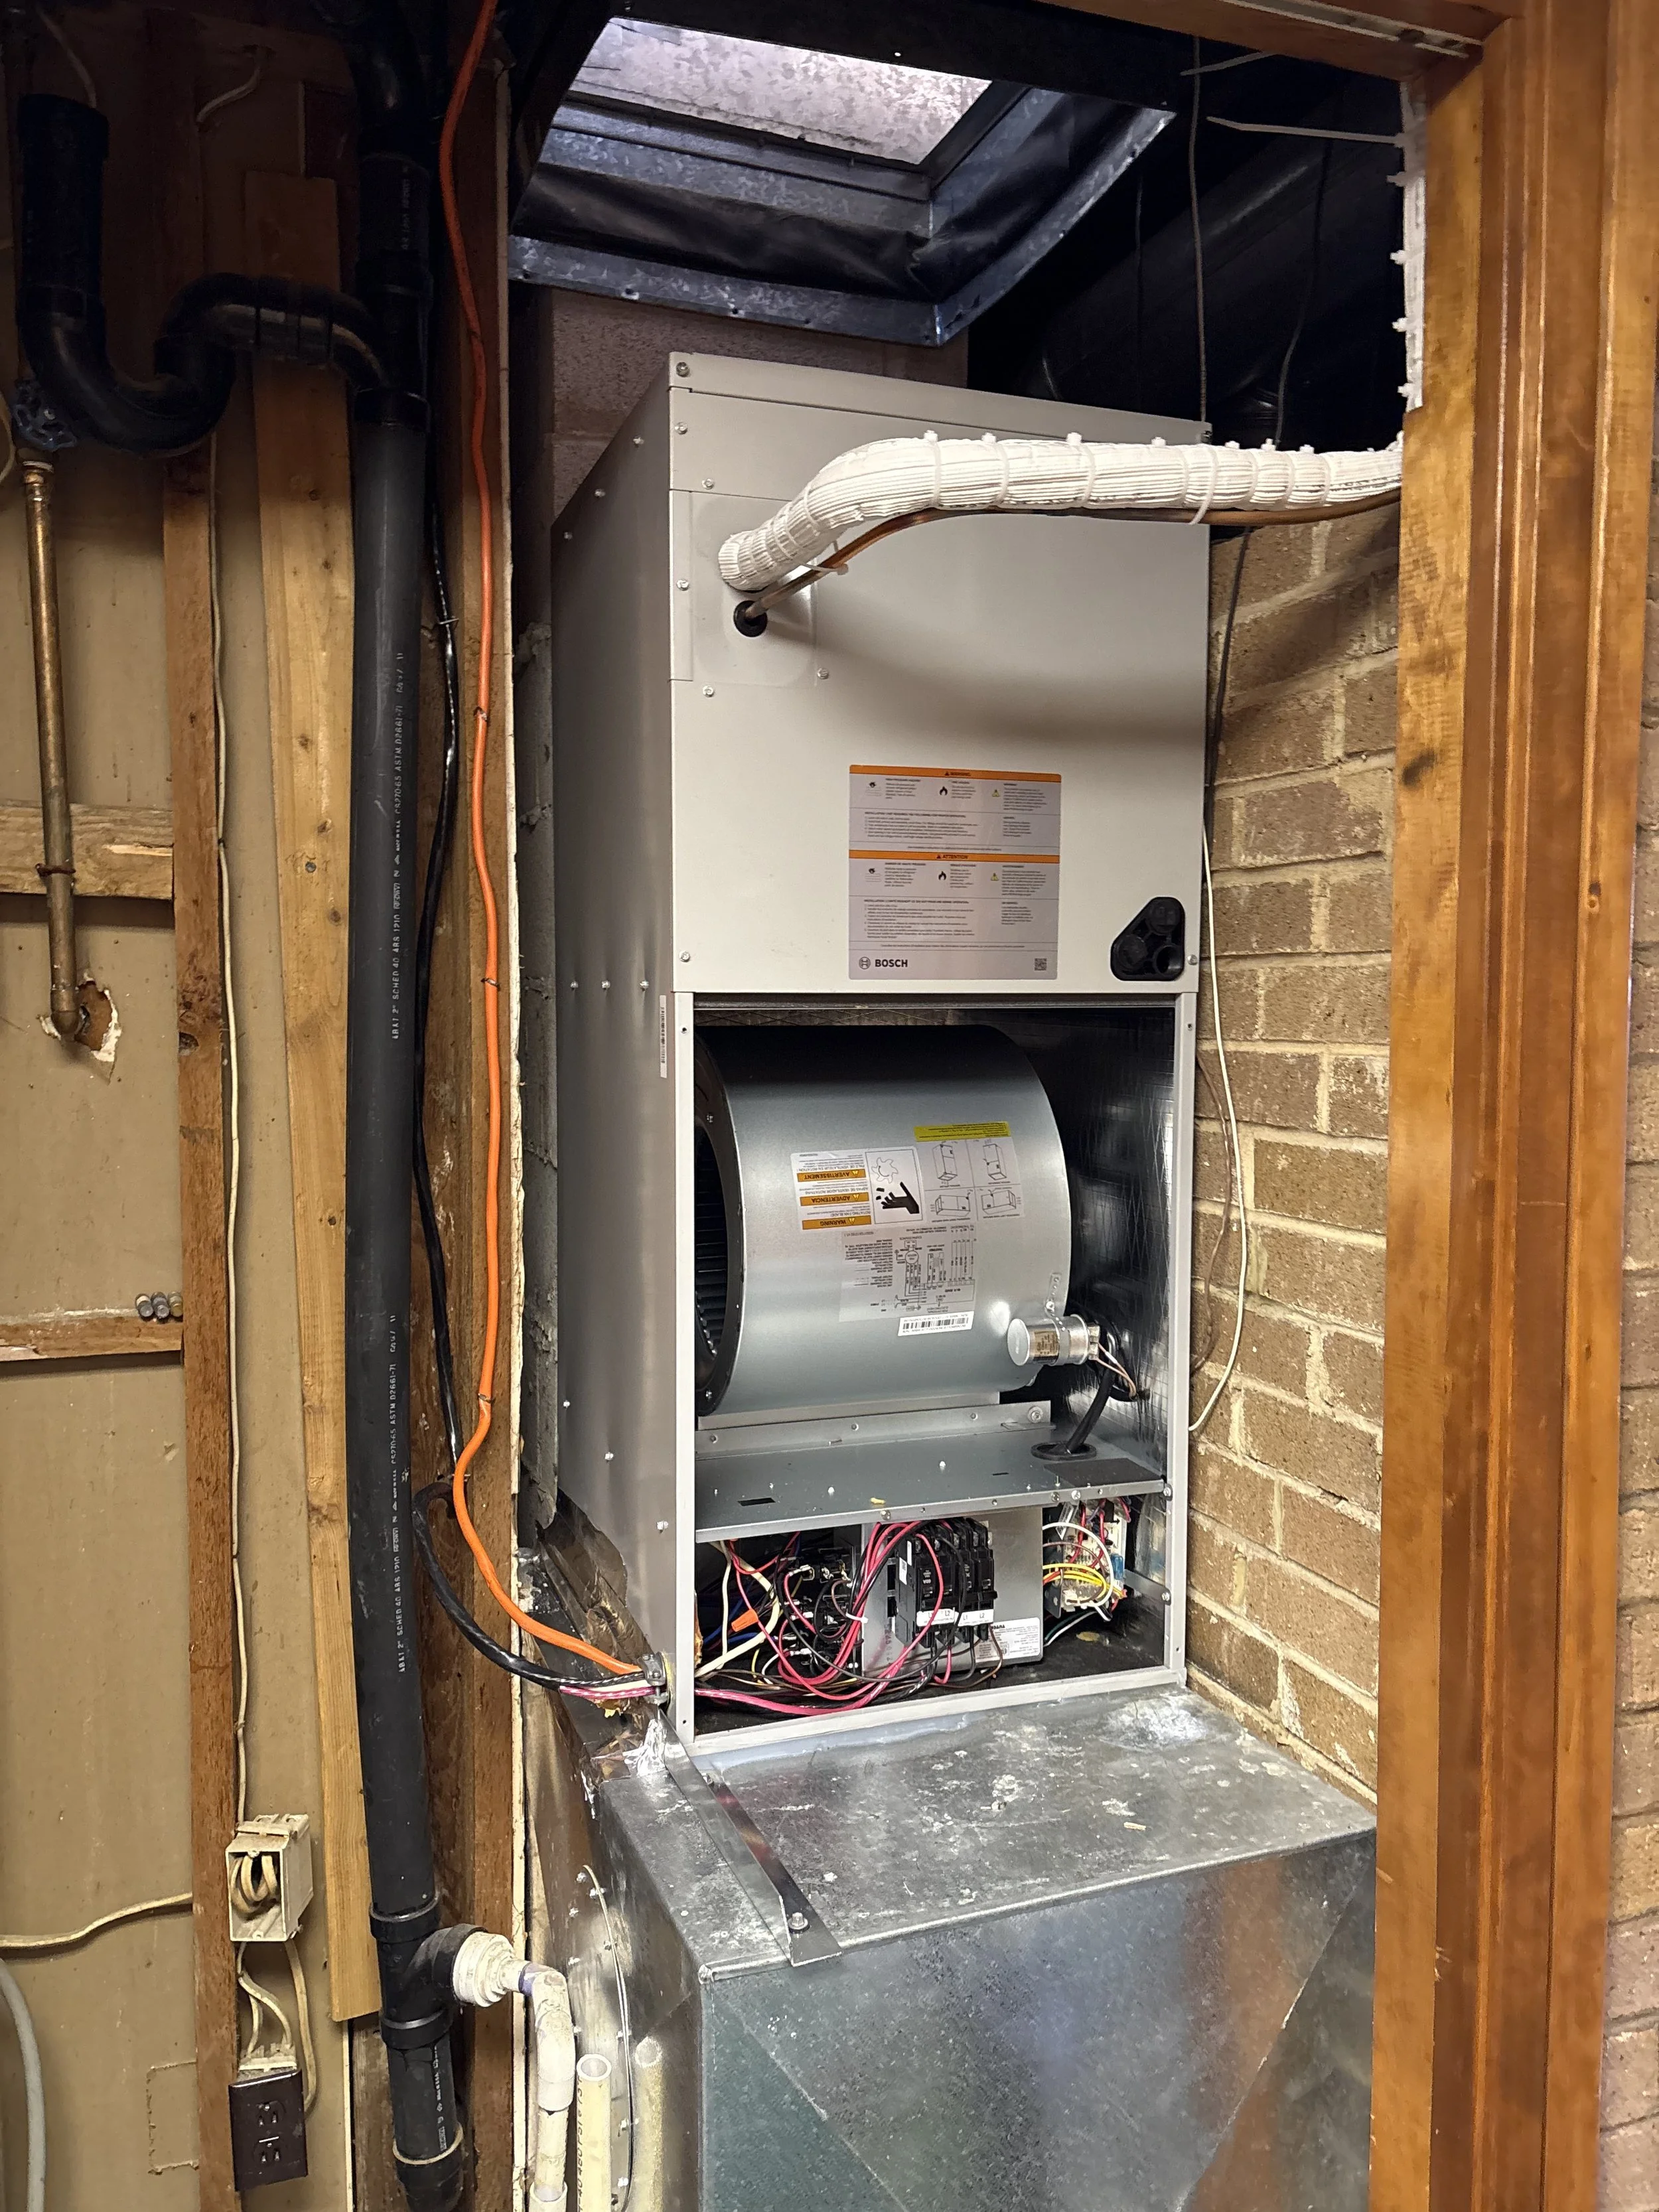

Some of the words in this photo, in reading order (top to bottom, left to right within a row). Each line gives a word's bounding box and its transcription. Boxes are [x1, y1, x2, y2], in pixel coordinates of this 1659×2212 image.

[392, 957, 399, 969] 40
[875, 959, 908, 968] BOSCH
[395, 1596, 401, 1607] 40
